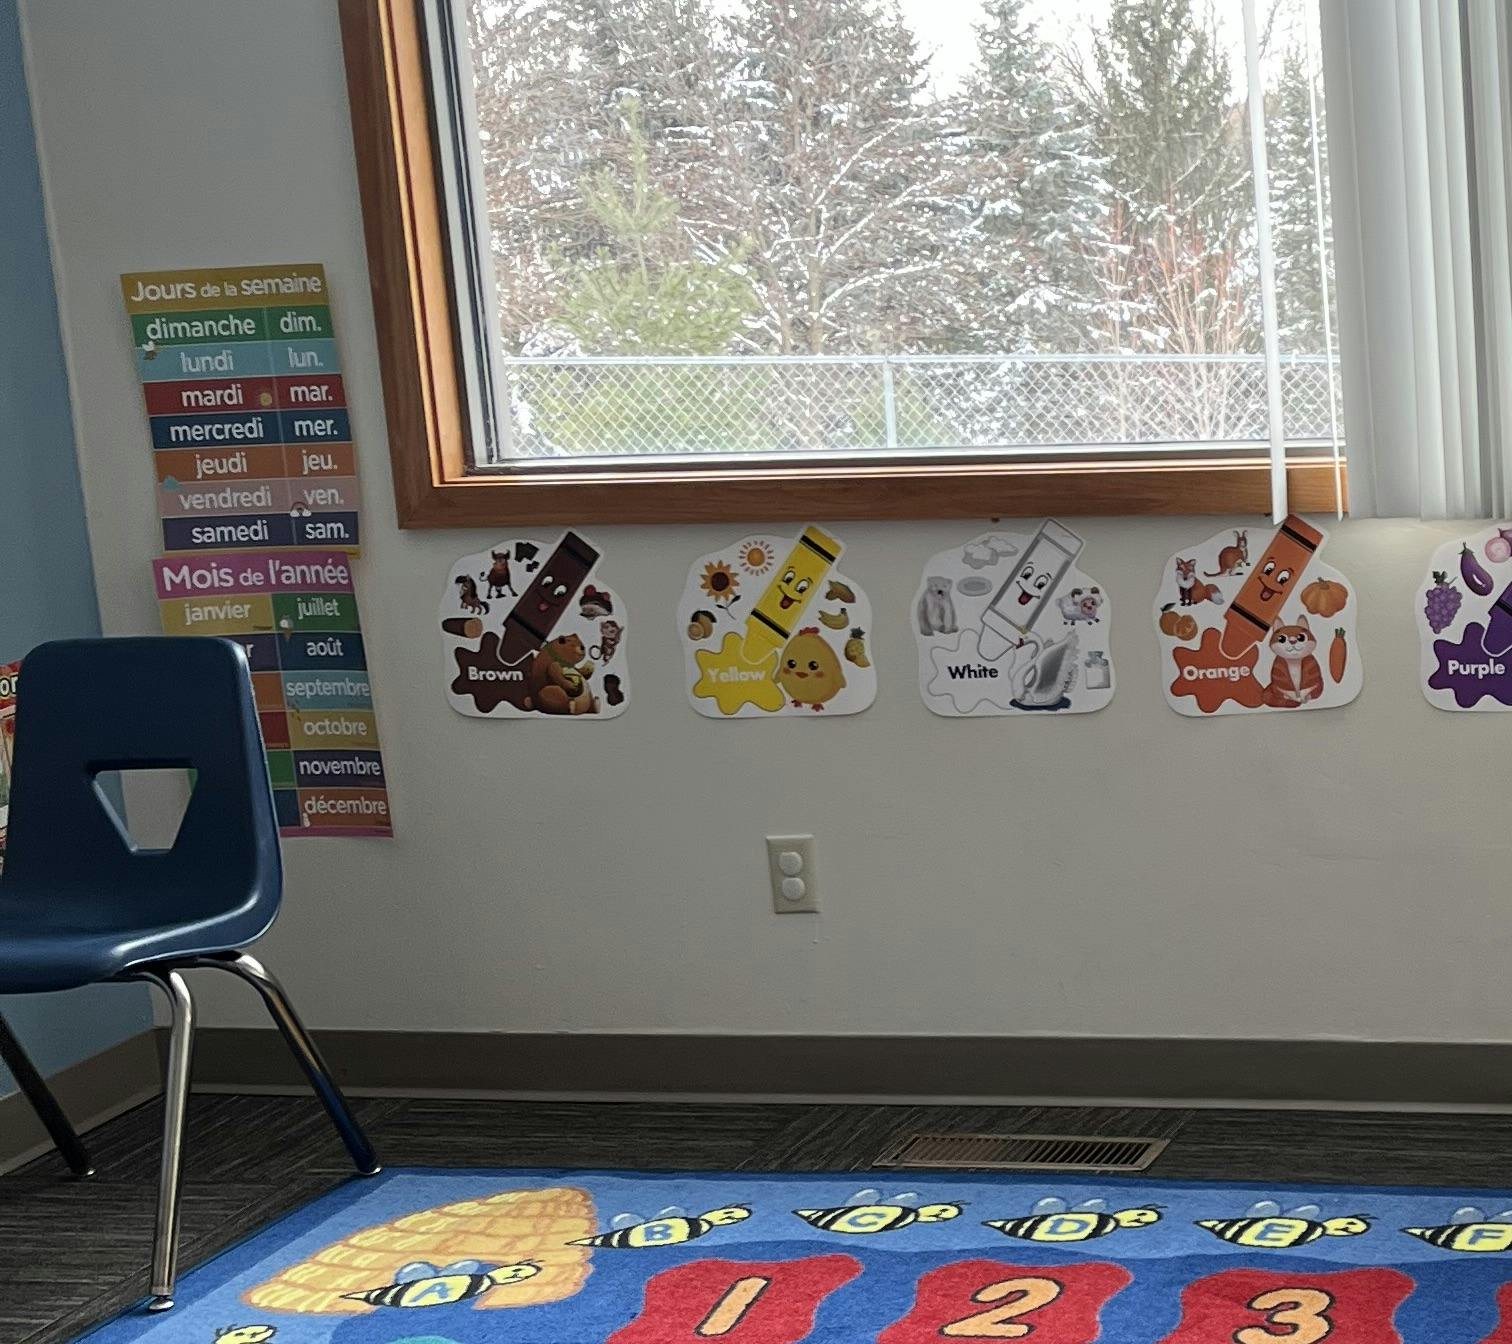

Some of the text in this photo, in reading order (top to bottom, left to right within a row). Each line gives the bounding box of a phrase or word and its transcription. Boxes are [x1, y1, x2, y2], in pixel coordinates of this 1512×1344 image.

[131, 273, 321, 302] Jours de la semaine
[146, 311, 322, 340] dimanche dim.
[180, 347, 324, 372] lundi lun.
[181, 383, 333, 407] mardi mar.
[170, 417, 338, 442] mercredi mer.
[196, 449, 338, 479] jeudi jeu.
[179, 485, 344, 510] vendredi ven.
[192, 519, 350, 544] samedi sam.
[162, 558, 349, 591] Mois de l'année
[185, 597, 340, 625] janvier juillet
[307, 637, 344, 657] août
[467, 665, 524, 683] Brown
[708, 667, 767, 684] Yellow
[948, 664, 1000, 681] White
[1182, 663, 1251, 684] Orange
[1448, 658, 1505, 679] Purple
[286, 677, 370, 699] septembre
[303, 718, 367, 737] octobre
[299, 756, 381, 776] novembre
[305, 796, 387, 815] décembre
[642, 1223, 670, 1244] B
[857, 1211, 887, 1229] C
[1049, 1219, 1086, 1236] D
[1254, 1224, 1291, 1242] E
[1469, 1227, 1510, 1246] F
[409, 1282, 456, 1304] A
[692, 1276, 772, 1338] 1
[940, 1277, 1067, 1340] 2
